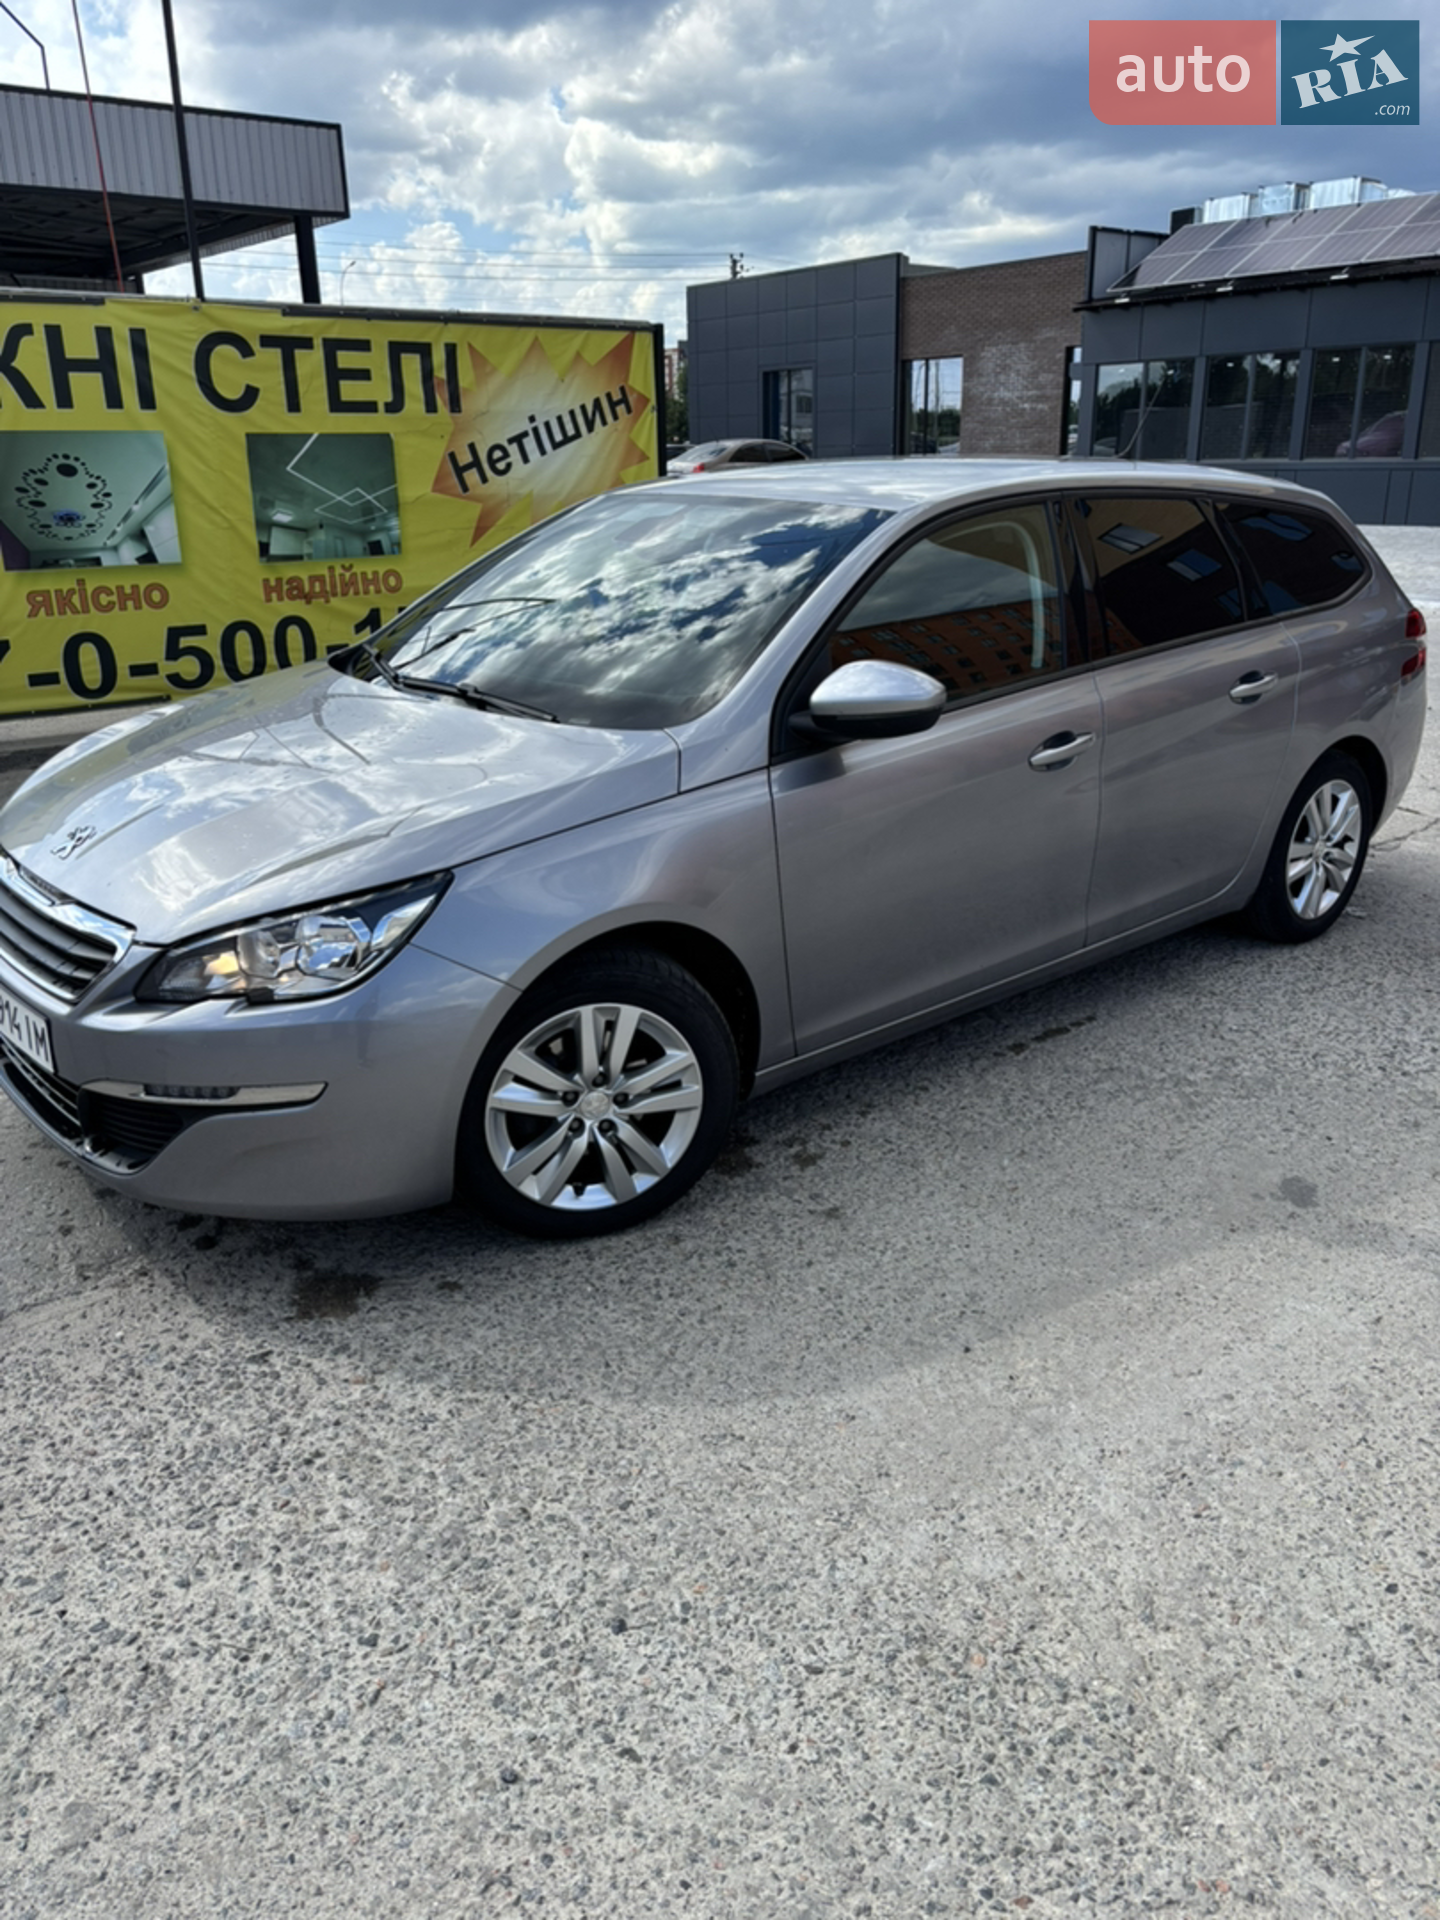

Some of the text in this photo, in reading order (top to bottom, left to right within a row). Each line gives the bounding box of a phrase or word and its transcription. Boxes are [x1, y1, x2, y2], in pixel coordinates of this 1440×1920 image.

[195, 331, 461, 414] СТЕЛІ
[447, 385, 633, 494] Нетішин
[26, 578, 169, 618] якісно
[262, 564, 402, 604] надійно
[25, 1015, 49, 1062] IM
